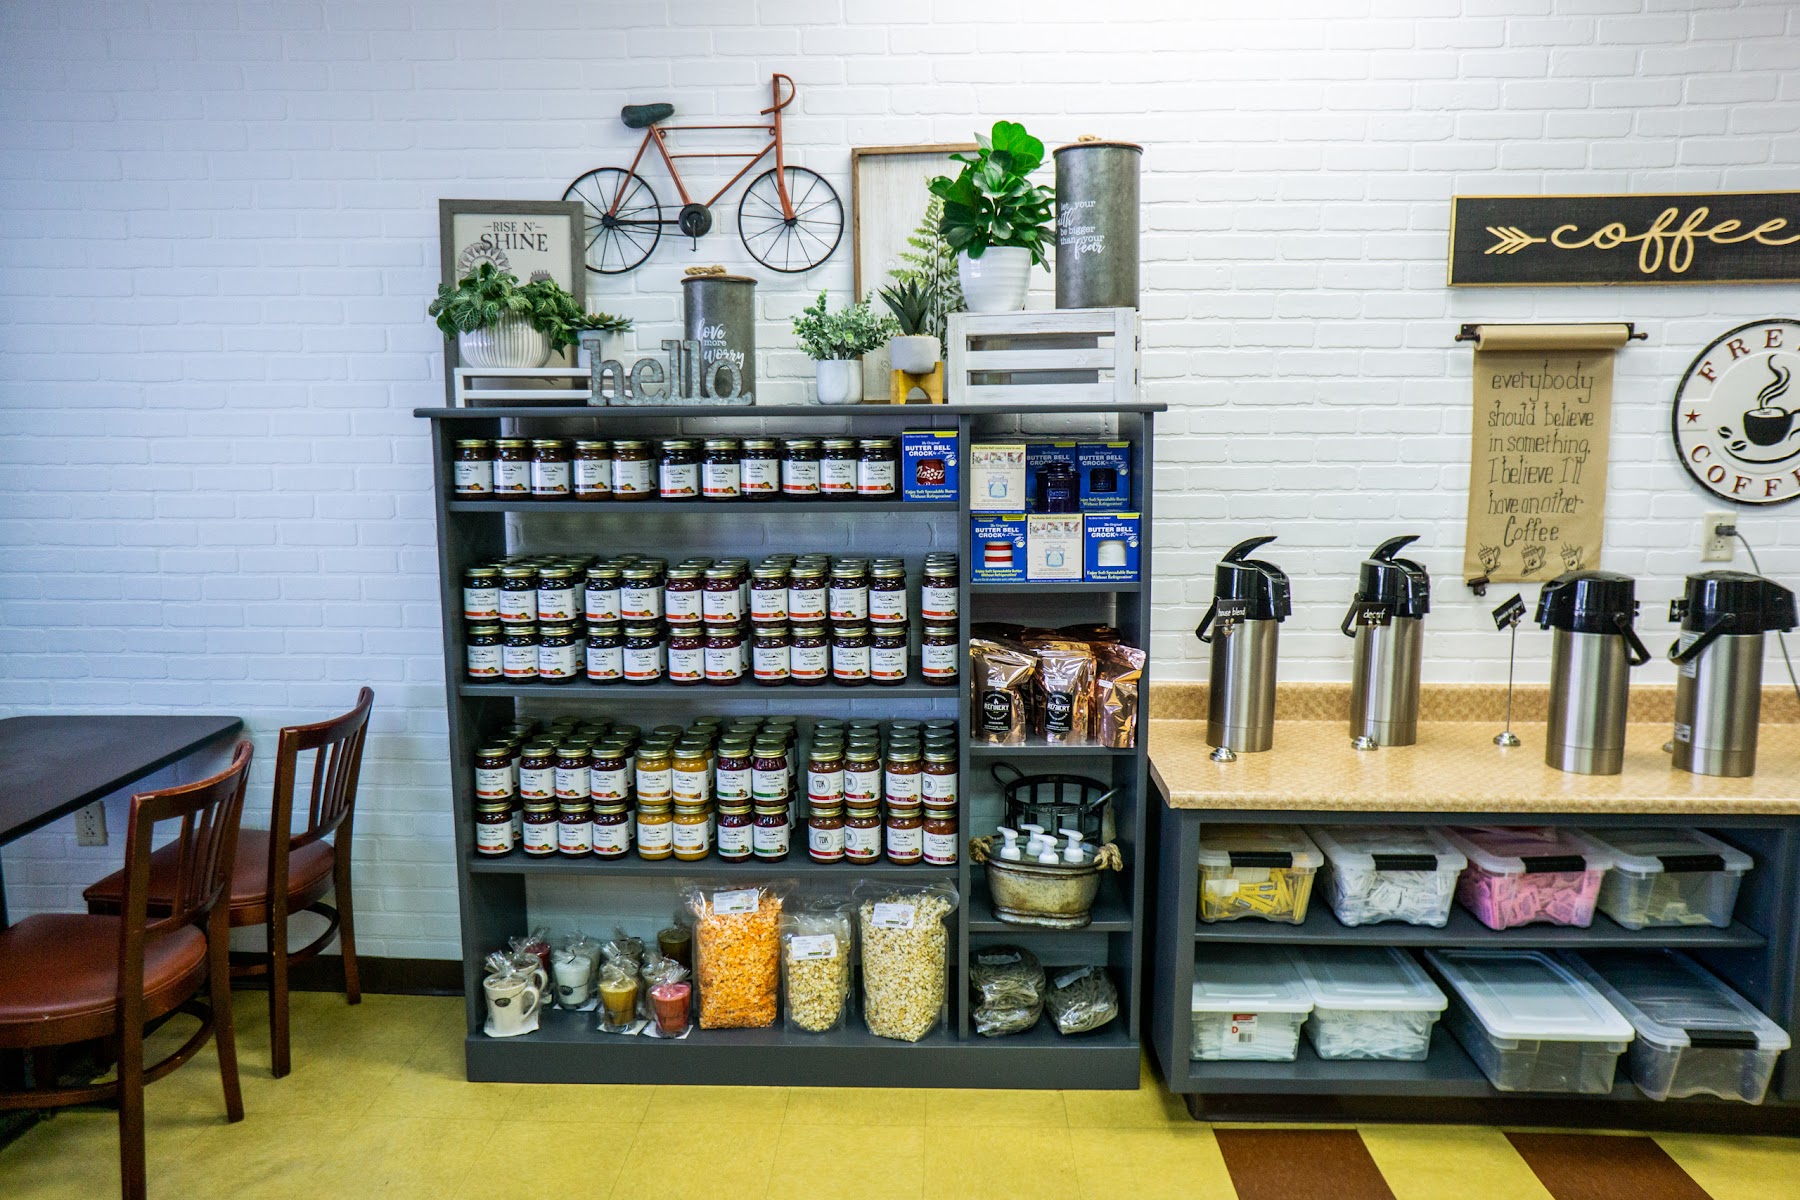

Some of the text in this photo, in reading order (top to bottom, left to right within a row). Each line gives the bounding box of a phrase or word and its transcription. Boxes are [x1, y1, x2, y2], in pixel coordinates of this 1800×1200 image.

[1074, 200, 1096, 210] your
[493, 221, 517, 232] RISE
[1060, 226, 1096, 236] be bigger
[480, 233, 548, 252] SHINE
[1060, 235, 1105, 245] than your
[1074, 238, 1106, 260] fear
[1551, 206, 1800, 273] coffee
[697, 318, 726, 341] love
[703, 349, 745, 370] worry
[1697, 328, 1800, 384] FRE
[583, 339, 754, 406] hello
[1492, 360, 1594, 404] everybody
[1488, 400, 1594, 427] should believe
[1488, 433, 1504, 452] in
[1488, 457, 1499, 485] I
[1501, 455, 1554, 485] believe
[1488, 488, 1584, 515] have another
[1503, 516, 1560, 548] Coffee
[1218, 606, 1246, 617] house blend
[984, 703, 1009, 711] REFINERY
